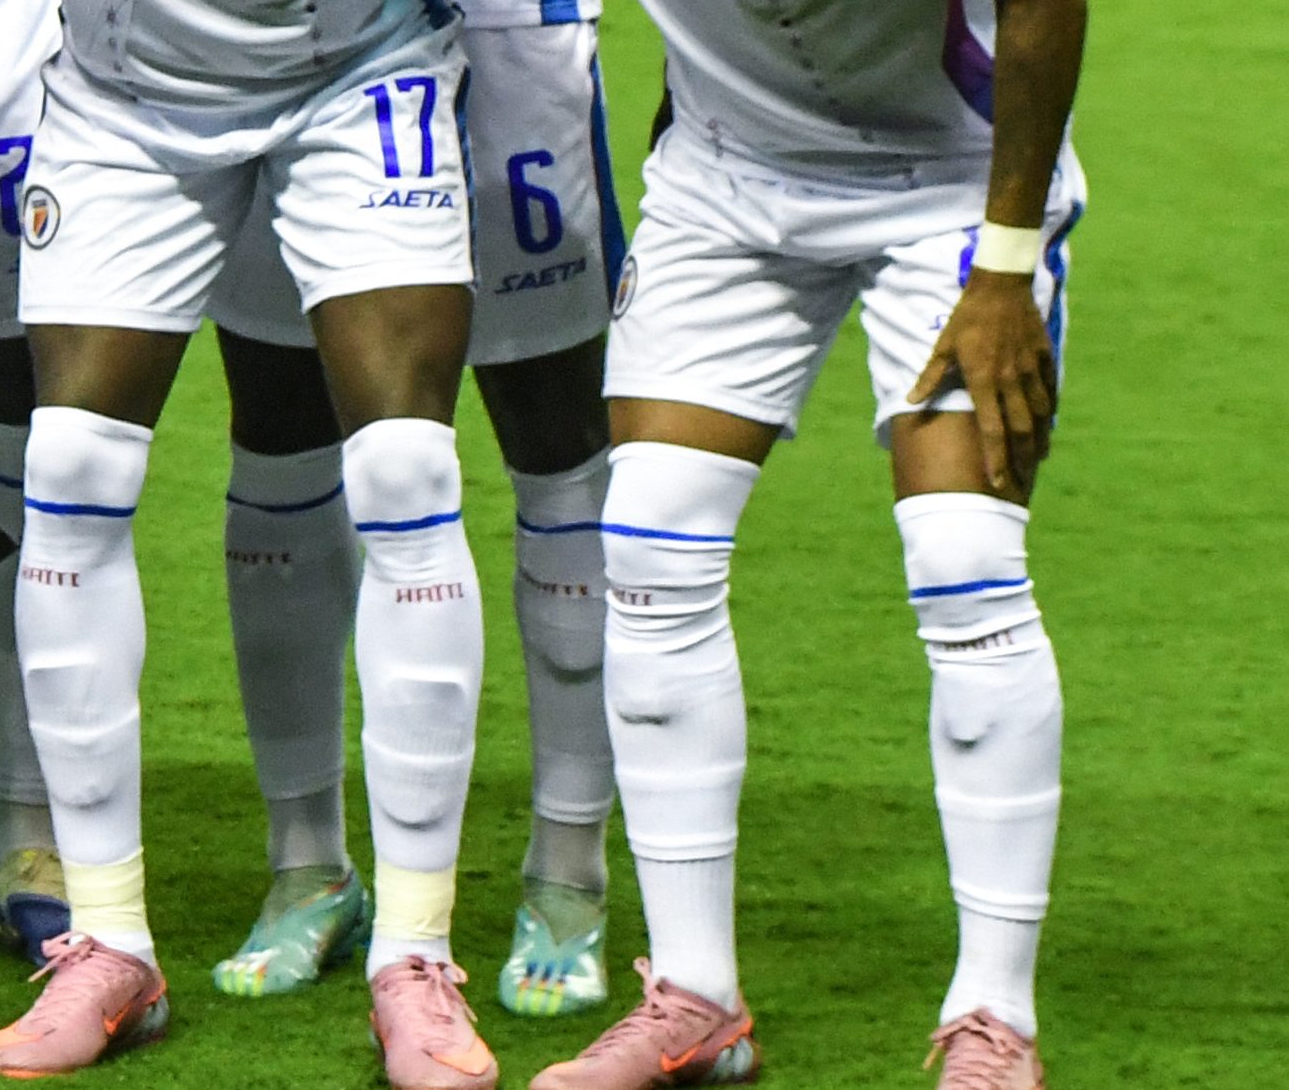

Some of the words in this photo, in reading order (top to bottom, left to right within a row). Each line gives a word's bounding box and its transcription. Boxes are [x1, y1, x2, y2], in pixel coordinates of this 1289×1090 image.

[364, 76, 438, 178] 17
[358, 189, 454, 209] SAETA
[507, 149, 563, 253] 6
[494, 257, 587, 294] SAETA
